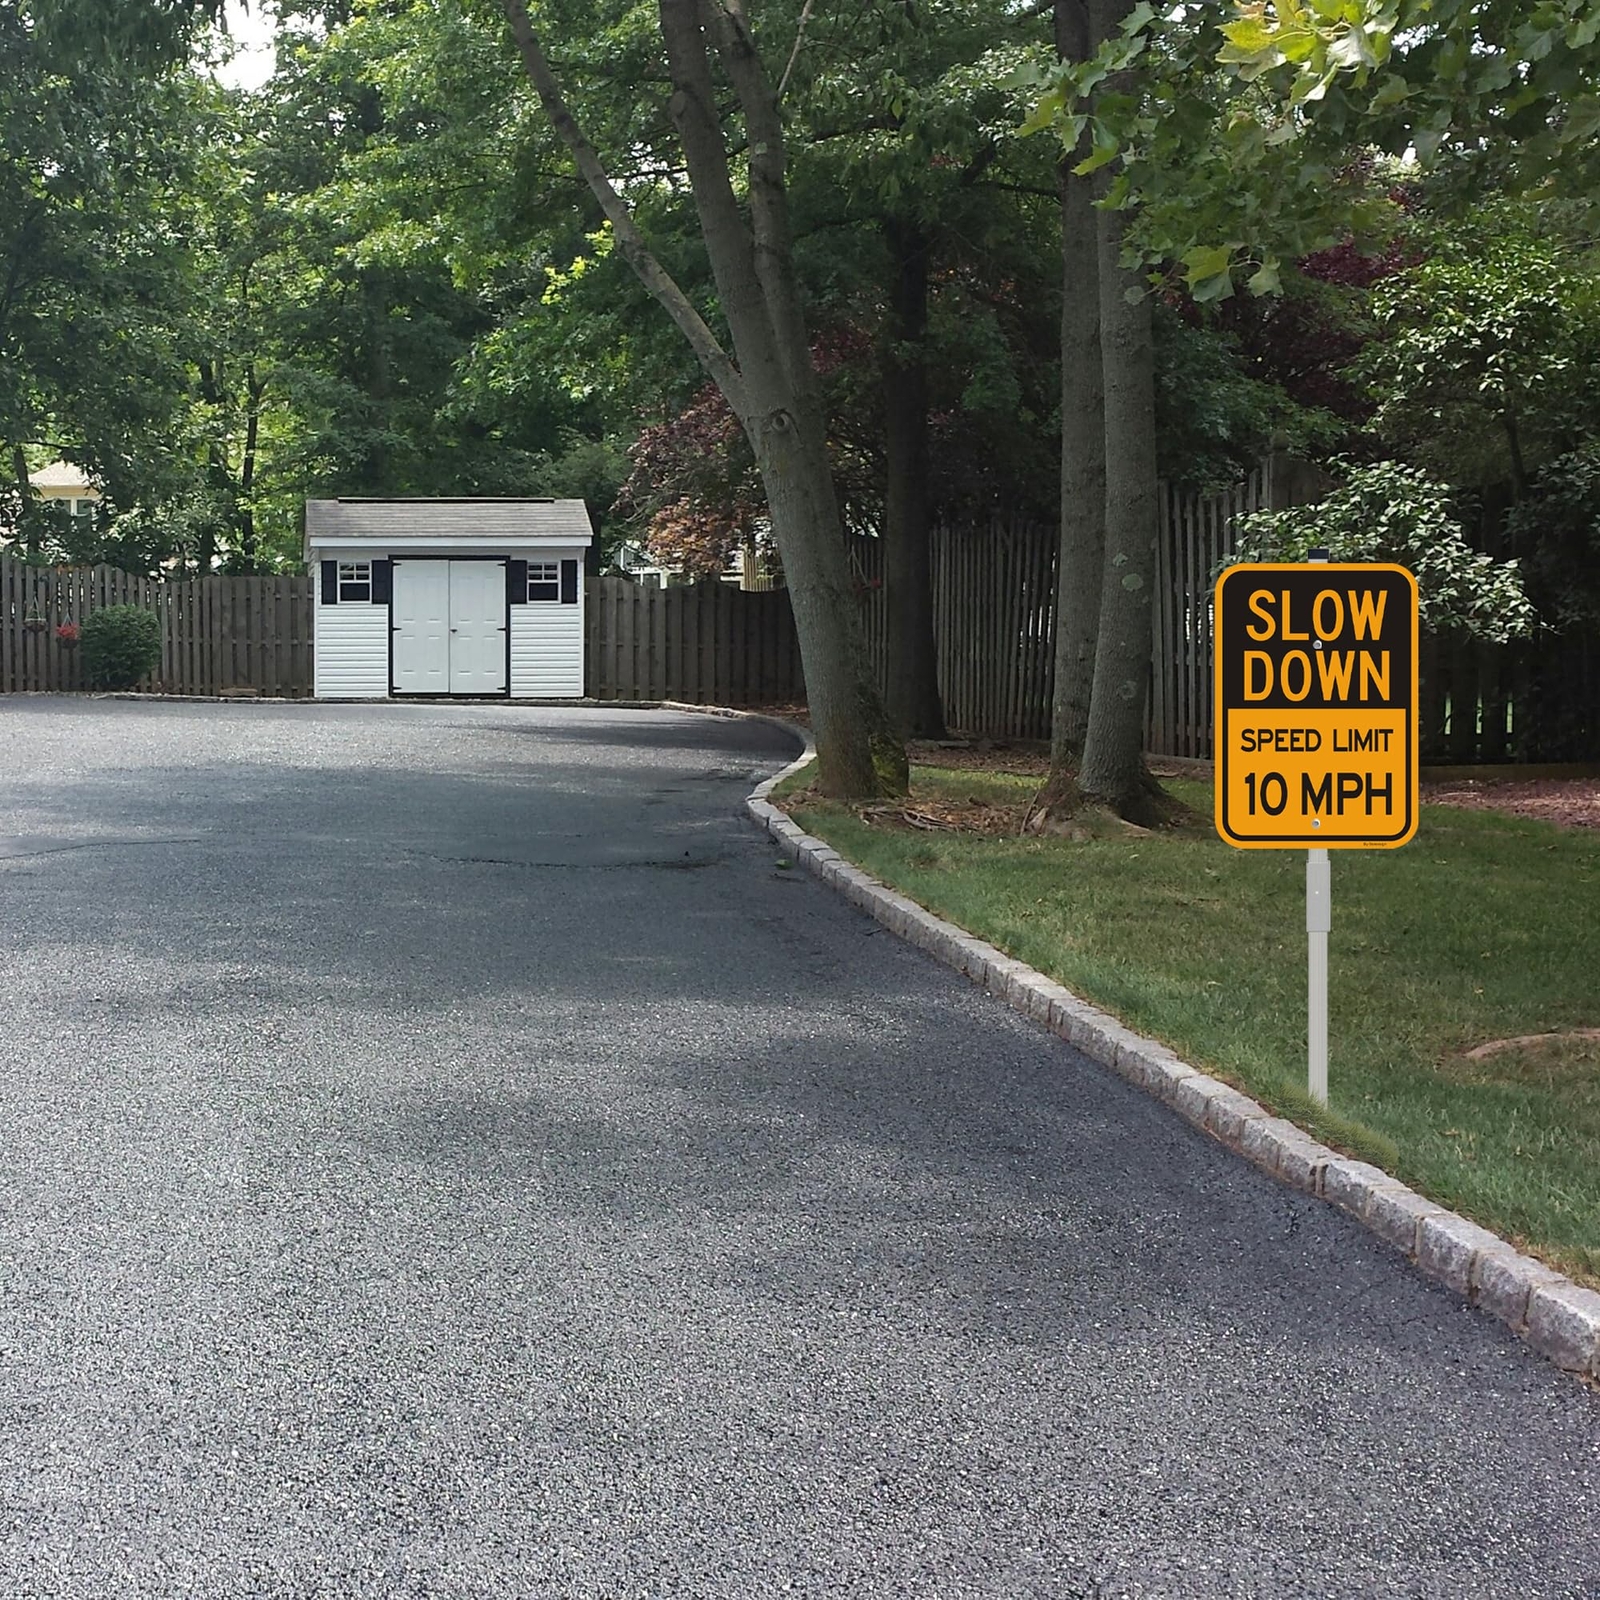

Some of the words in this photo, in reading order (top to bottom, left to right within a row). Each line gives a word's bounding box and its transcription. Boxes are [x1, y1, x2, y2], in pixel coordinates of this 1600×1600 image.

[1246, 589, 1388, 641] SLOW
[1244, 650, 1390, 701] DOWN
[1240, 728, 1322, 752] SPEED
[1333, 728, 1394, 752] LIMIT
[1245, 772, 1288, 815] 10
[1301, 772, 1393, 815] MPH
